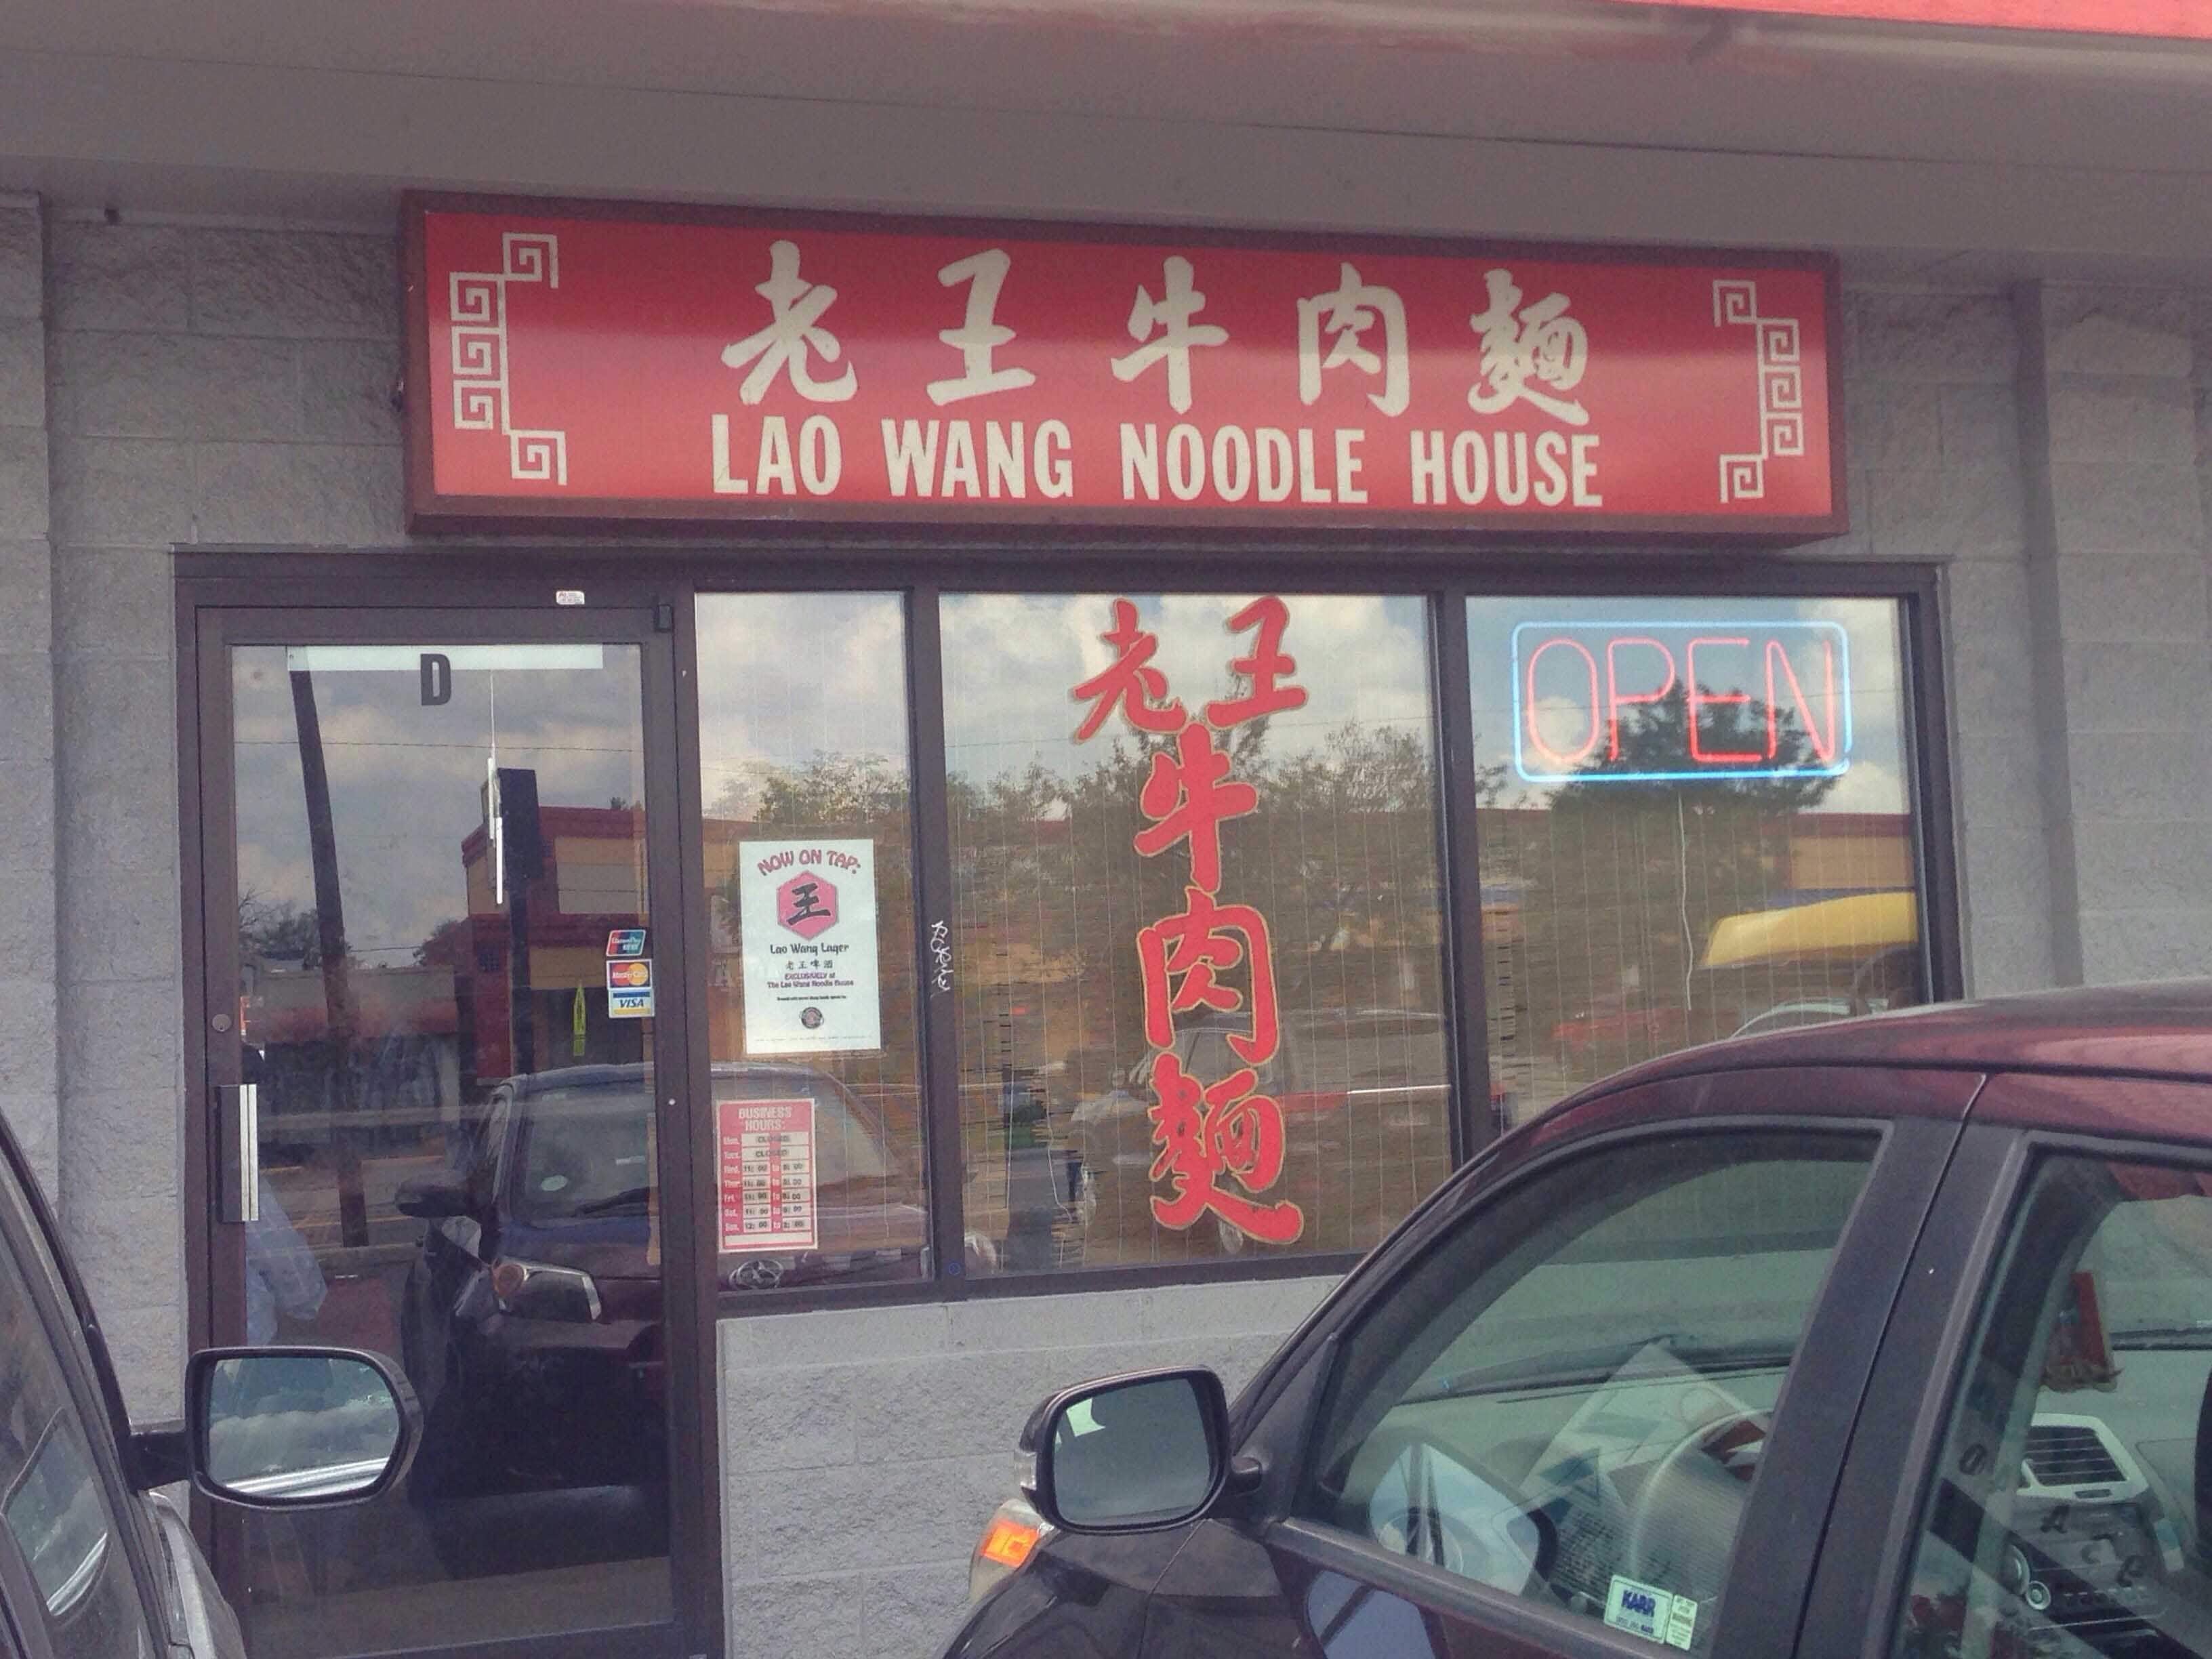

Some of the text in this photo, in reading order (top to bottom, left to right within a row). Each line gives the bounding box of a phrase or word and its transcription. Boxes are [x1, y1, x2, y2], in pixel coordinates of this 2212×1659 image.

[712, 414, 1603, 507] LAO WANG NOODLE HOUSE
[420, 653, 452, 706] D
[1525, 637, 1838, 763] OPEN
[757, 851, 795, 876] NOW
[798, 848, 823, 865] ON
[785, 882, 832, 926] 王
[770, 942, 850, 957] Lao Wang Lager
[767, 981, 779, 989] The
[834, 979, 855, 987] House
[619, 998, 644, 1008] VISA
[738, 1105, 792, 1119] BUSINESS
[745, 1118, 787, 1132] HOURS:
[1621, 1589, 1656, 1618] KARR
